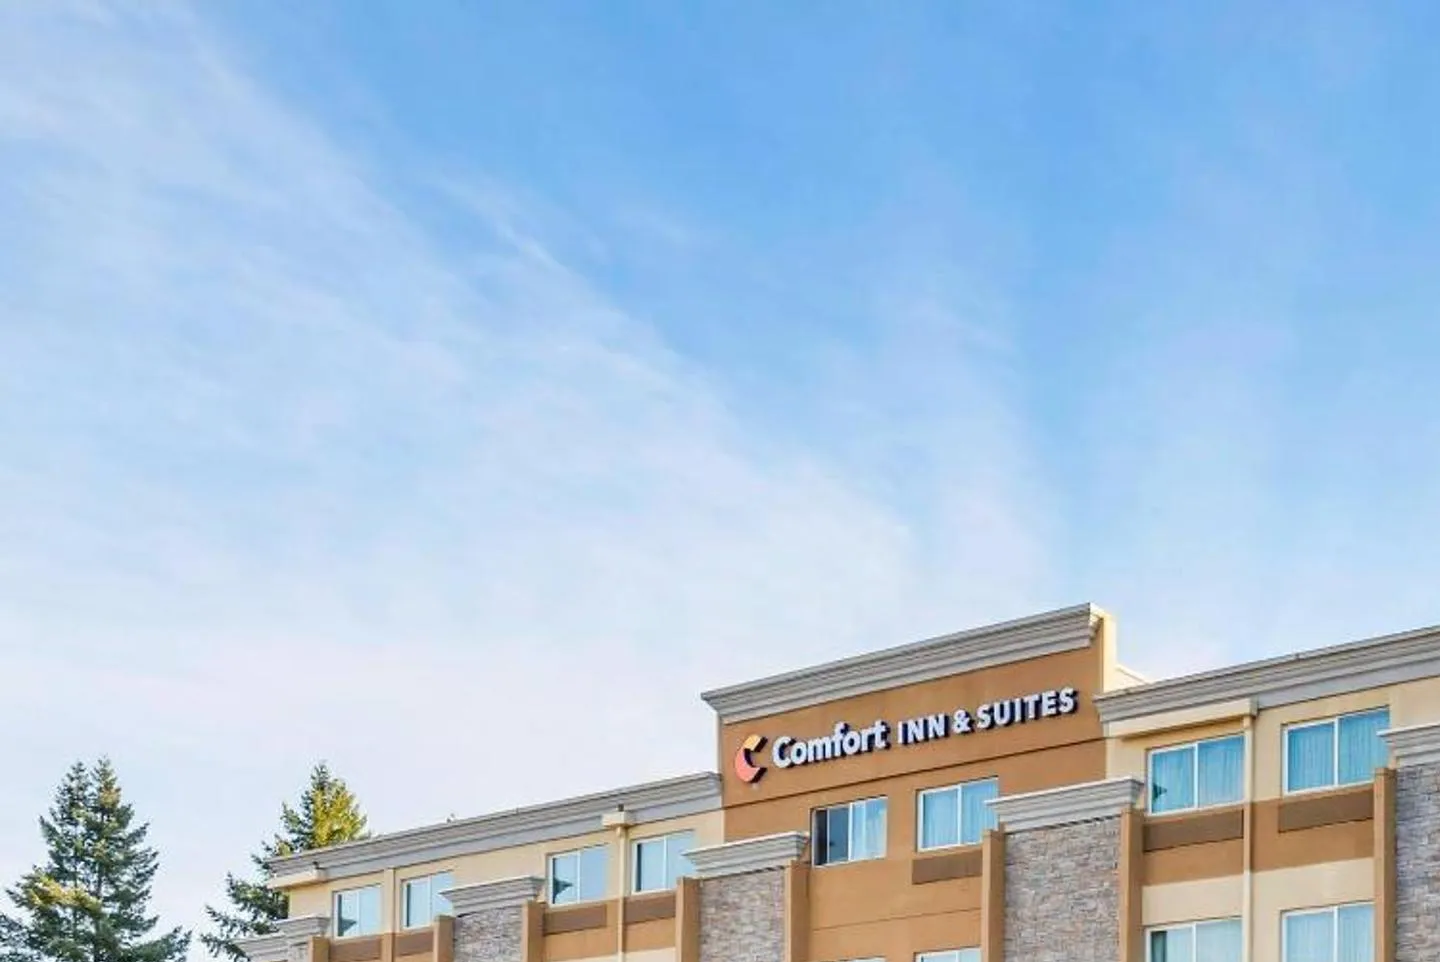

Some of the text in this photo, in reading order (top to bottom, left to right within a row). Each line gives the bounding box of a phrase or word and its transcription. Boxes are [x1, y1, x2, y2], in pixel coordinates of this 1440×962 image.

[772, 719, 890, 769] Comfort
[897, 712, 949, 745] INN
[953, 709, 974, 735] &
[976, 686, 1077, 731] SUITES
